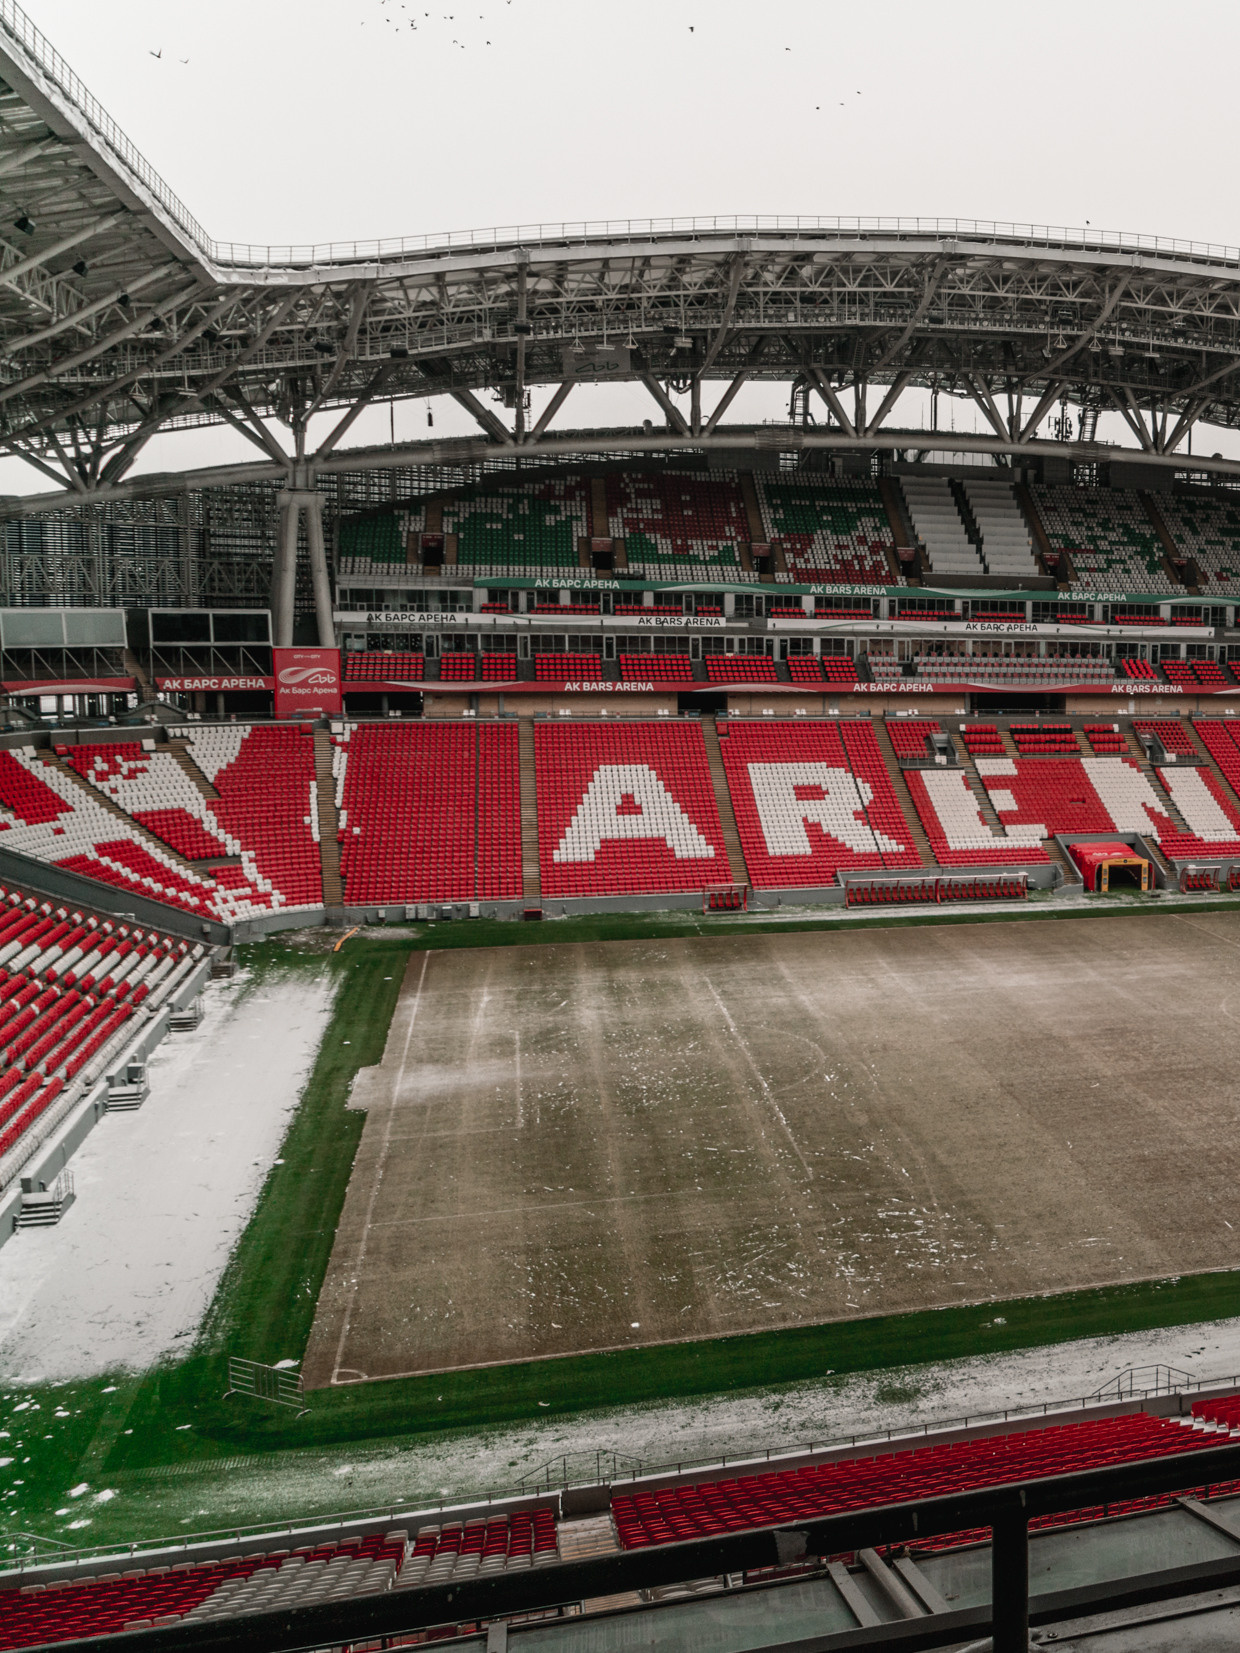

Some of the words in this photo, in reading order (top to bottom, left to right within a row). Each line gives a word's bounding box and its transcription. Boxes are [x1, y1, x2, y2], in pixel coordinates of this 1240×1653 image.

[535, 579, 550, 588] АК
[553, 579, 581, 588] БАРС
[584, 580, 620, 589] АРЕНА
[810, 586, 824, 594] AK
[826, 586, 852, 594] BARS
[854, 586, 887, 595] ARENA
[1058, 592, 1070, 600] АК
[1072, 592, 1096, 600] БАРС
[1097, 592, 1126, 601] АРЕНА
[367, 614, 382, 622] АК
[385, 614, 416, 622] БАРС
[418, 614, 456, 622] АРЕНА
[638, 617, 652, 625] AK
[656, 617, 682, 626] BARS
[686, 618, 721, 626] ARENA
[966, 623, 978, 631] АК
[981, 624, 1005, 632] БАРС
[1007, 624, 1038, 632] АРЕНА
[163, 680, 180, 689] АК
[184, 680, 218, 688] БАРС
[222, 678, 265, 688] АРЕНА
[564, 682, 582, 691] AK
[584, 682, 612, 691] BARS
[615, 682, 654, 691] ARENA
[854, 683, 868, 692] АК
[870, 684, 897, 692] БАРС
[899, 684, 933, 692] АРЕНА
[1112, 685, 1125, 693] AK
[1127, 685, 1150, 693] BARS
[1152, 685, 1182, 693] ARENA
